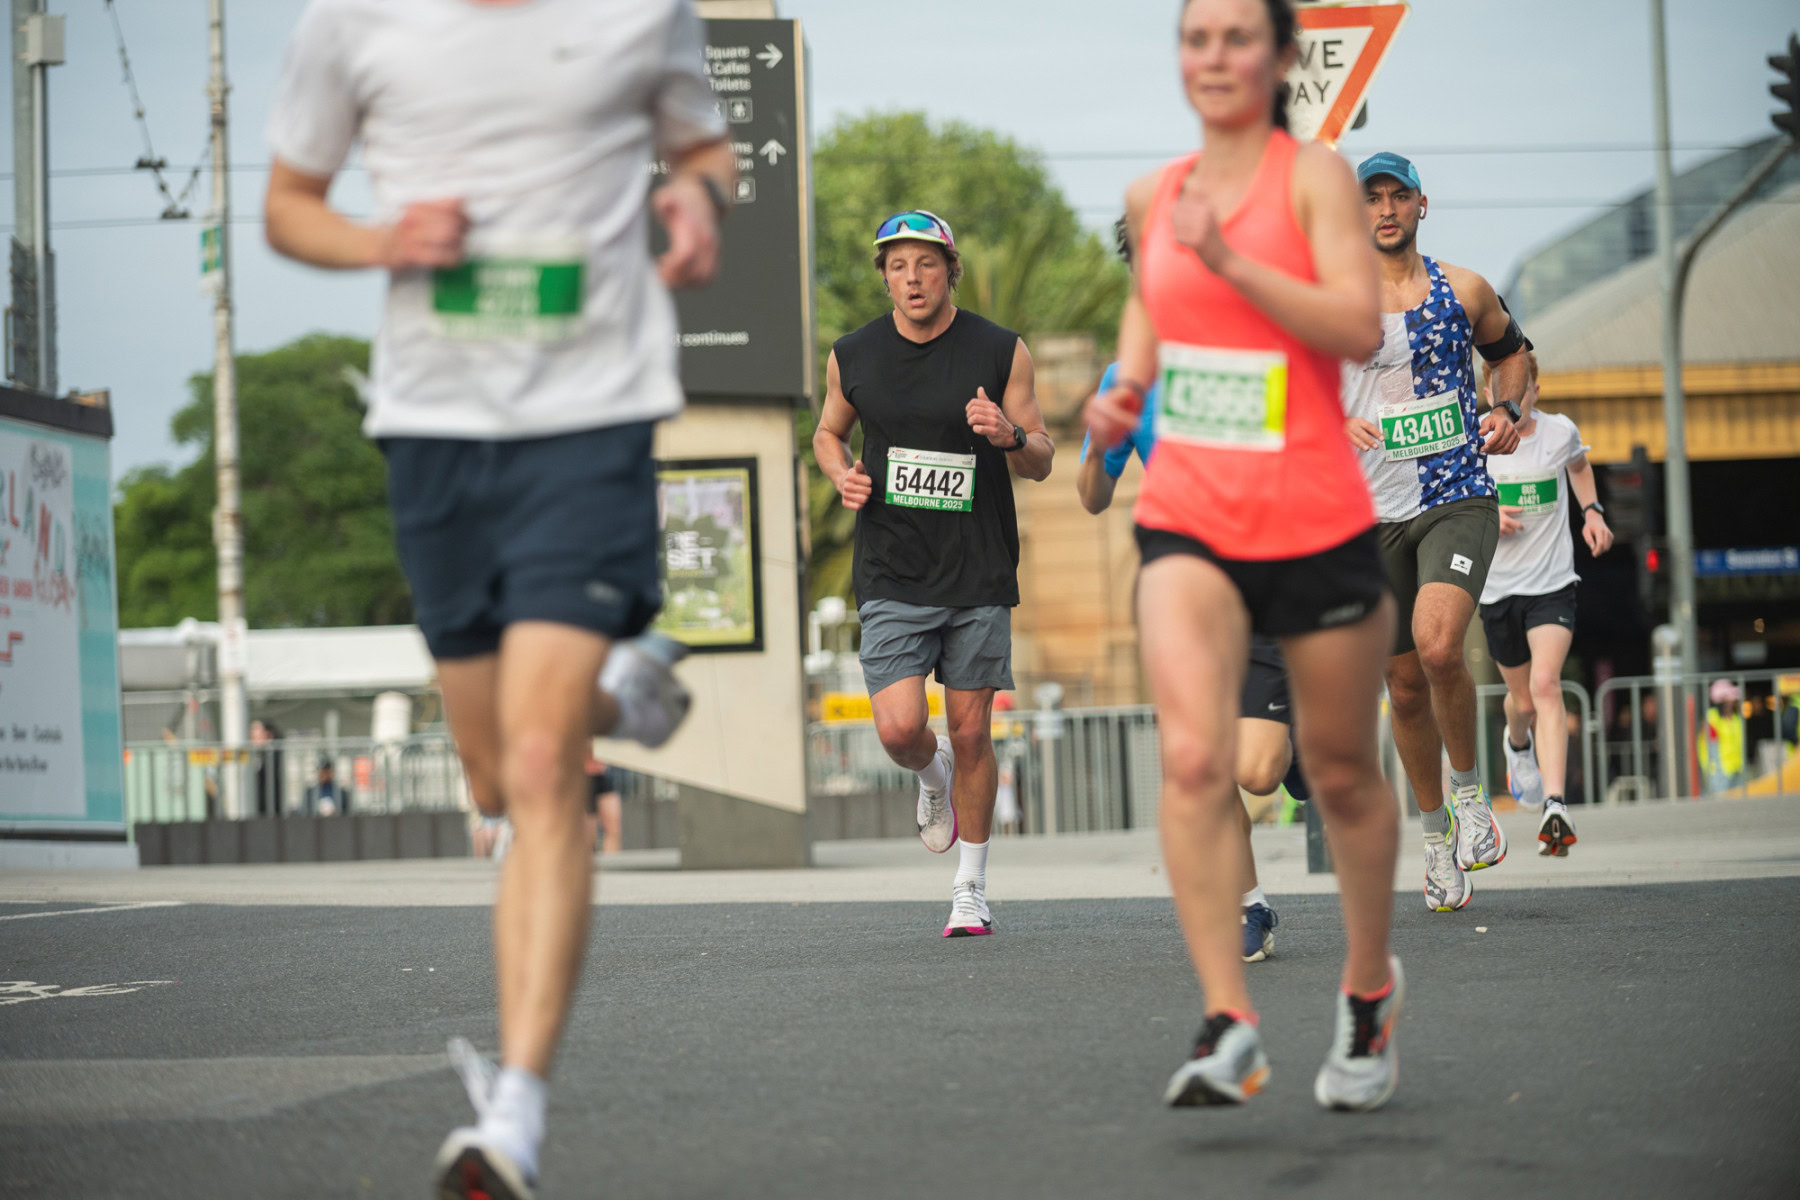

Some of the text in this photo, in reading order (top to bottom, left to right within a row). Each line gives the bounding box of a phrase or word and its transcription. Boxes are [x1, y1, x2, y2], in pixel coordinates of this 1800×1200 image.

[1297, 40, 1344, 69] VE
[1294, 80, 1330, 105] AY
[1392, 408, 1455, 446] 43416
[1392, 436, 1460, 459] MELBOURNE 2025
[895, 465, 965, 498] 54442
[1521, 483, 1537, 496] GUS
[893, 494, 963, 509] MELBOURNE 2025
[1518, 494, 1540, 505] 41421
